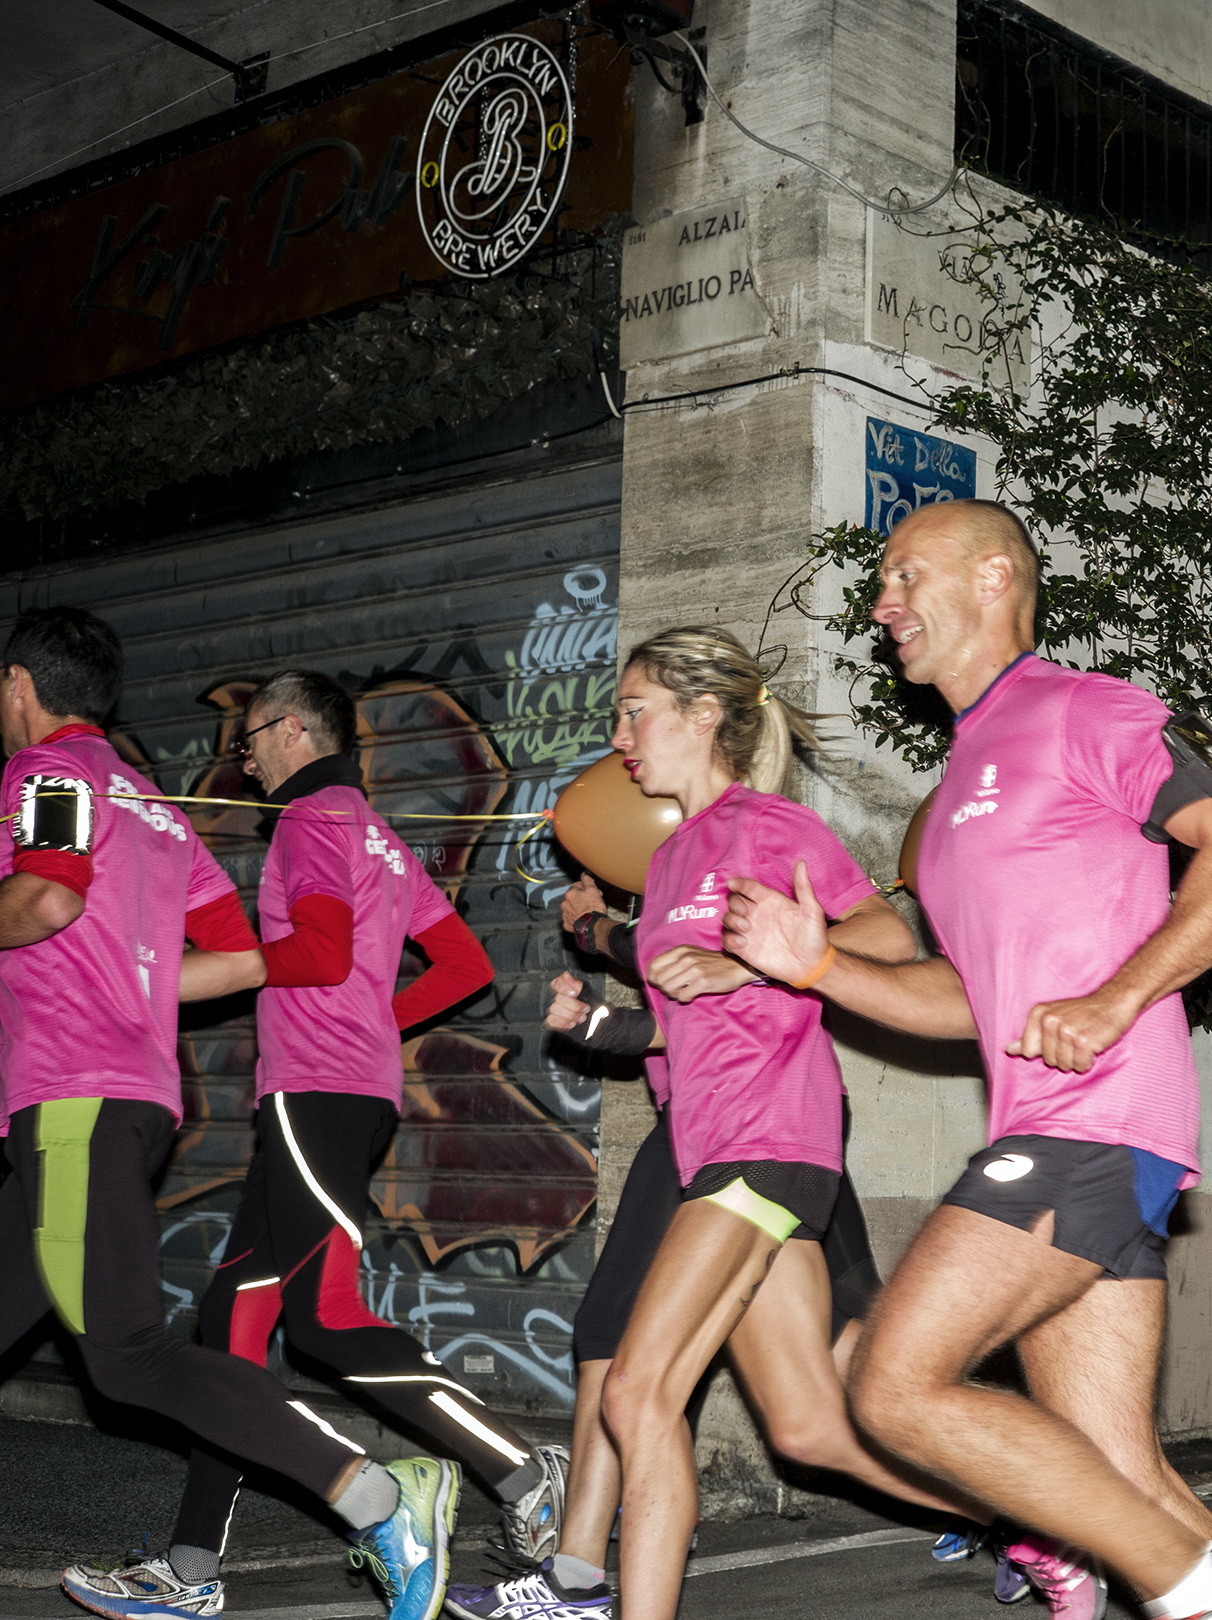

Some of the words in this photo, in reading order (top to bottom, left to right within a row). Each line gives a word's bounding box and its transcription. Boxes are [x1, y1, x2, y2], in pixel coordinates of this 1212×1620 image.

[435, 41, 558, 126] BROOKLYN
[432, 188, 548, 270] BREWERY
[624, 275, 722, 322] NAVIGLIO
